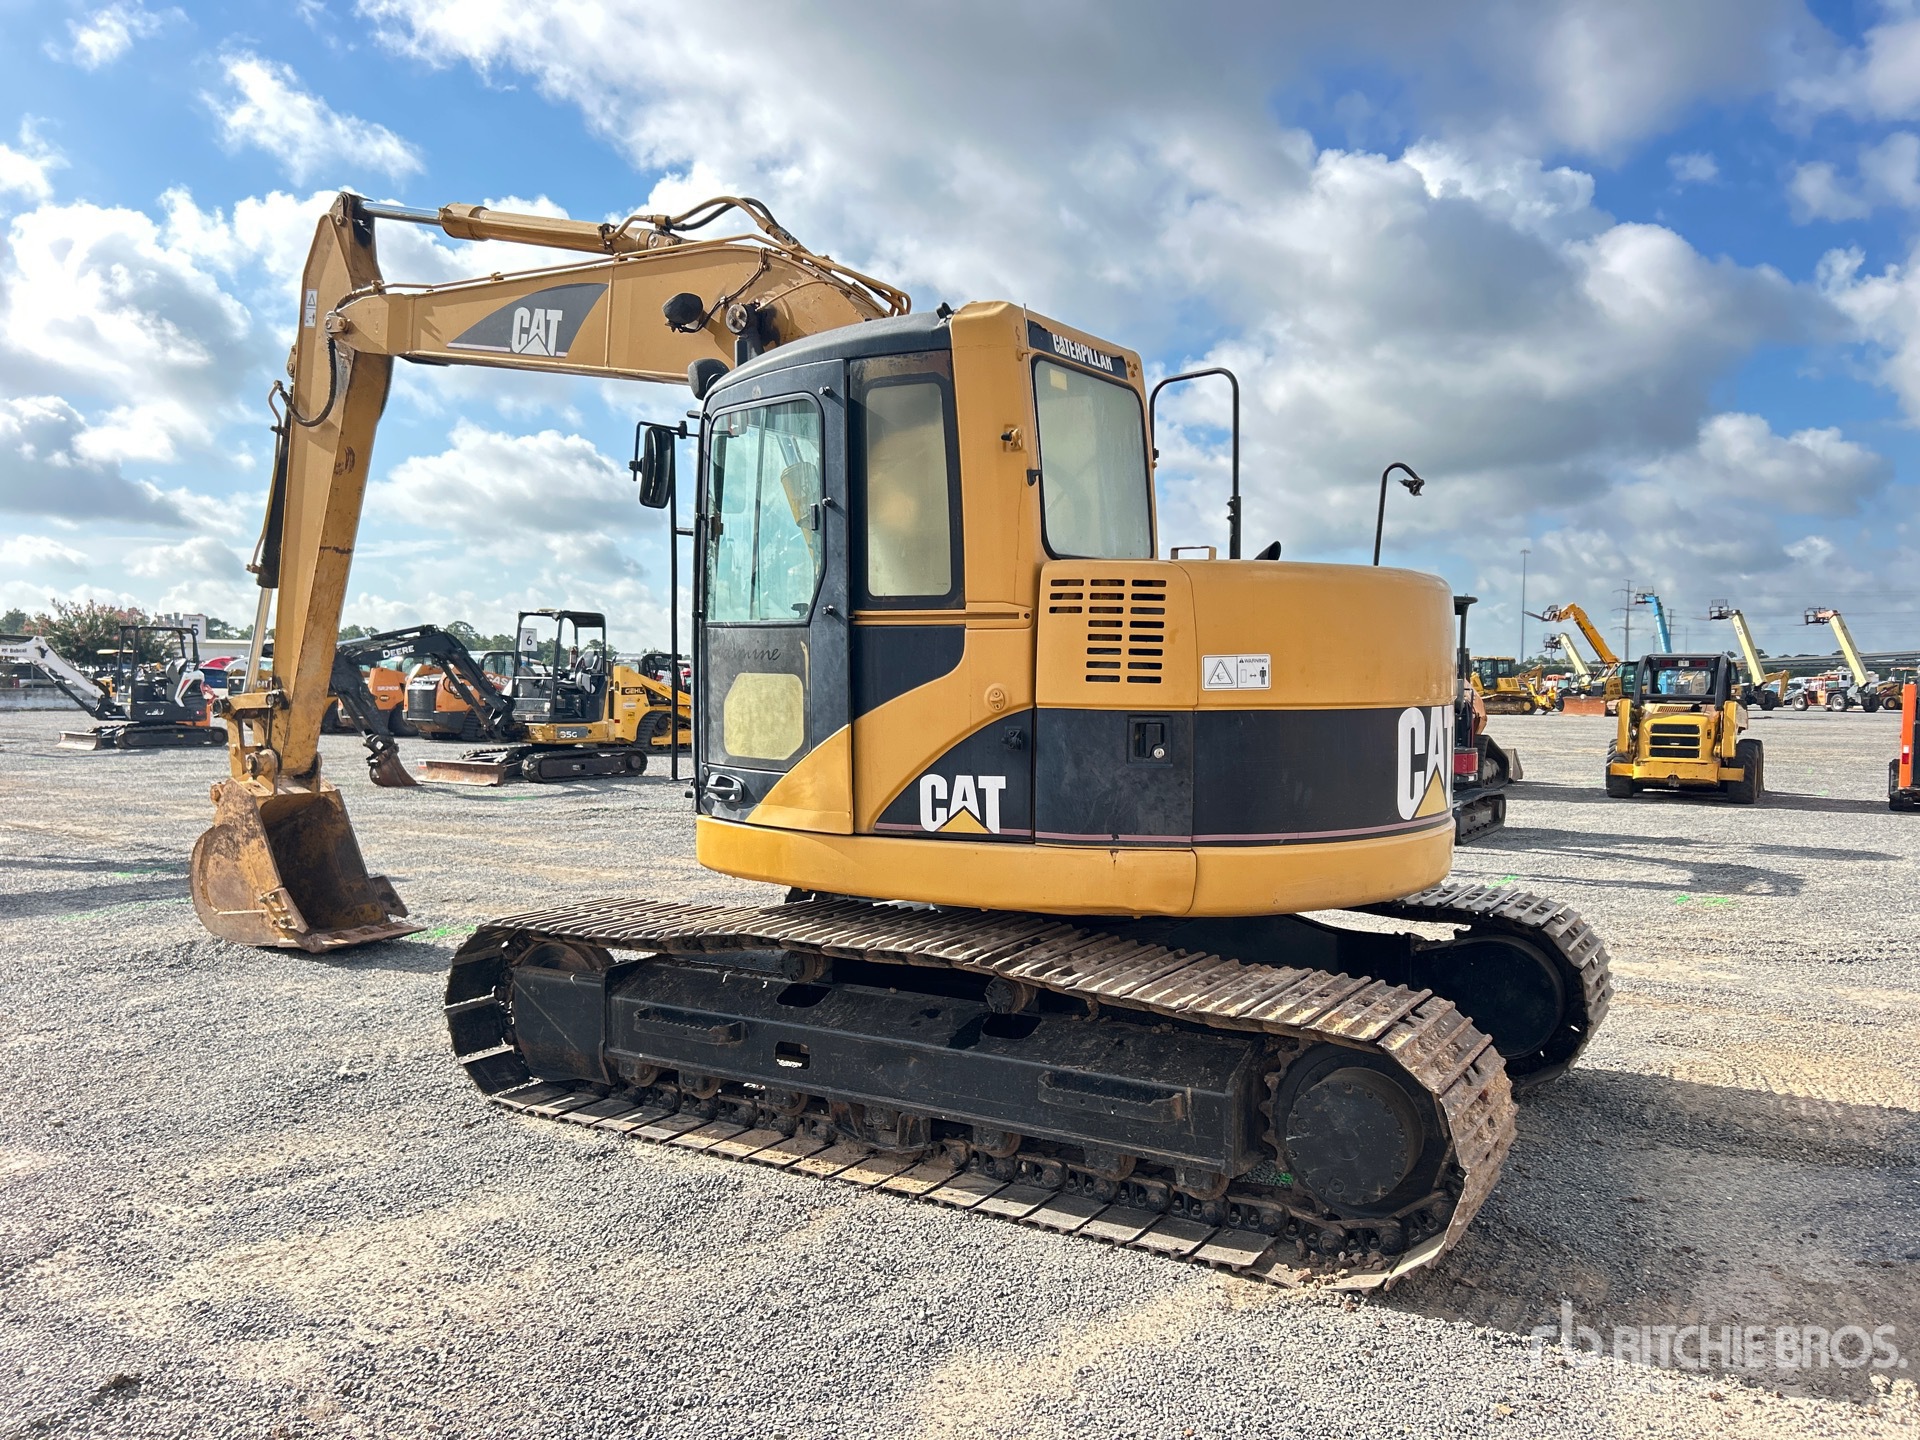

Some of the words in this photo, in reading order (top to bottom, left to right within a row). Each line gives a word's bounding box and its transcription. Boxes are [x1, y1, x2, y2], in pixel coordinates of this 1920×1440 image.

[511, 306, 563, 357] CAT
[1052, 333, 1113, 371] CATERPILLAR
[191, 624, 199, 636] 5
[526, 635, 533, 646] 6
[382, 645, 415, 659] DEERE
[256, 680, 268, 688] CAT
[486, 673, 509, 686] CAS
[1397, 705, 1454, 821] CAT
[920, 773, 1006, 834] CAT
